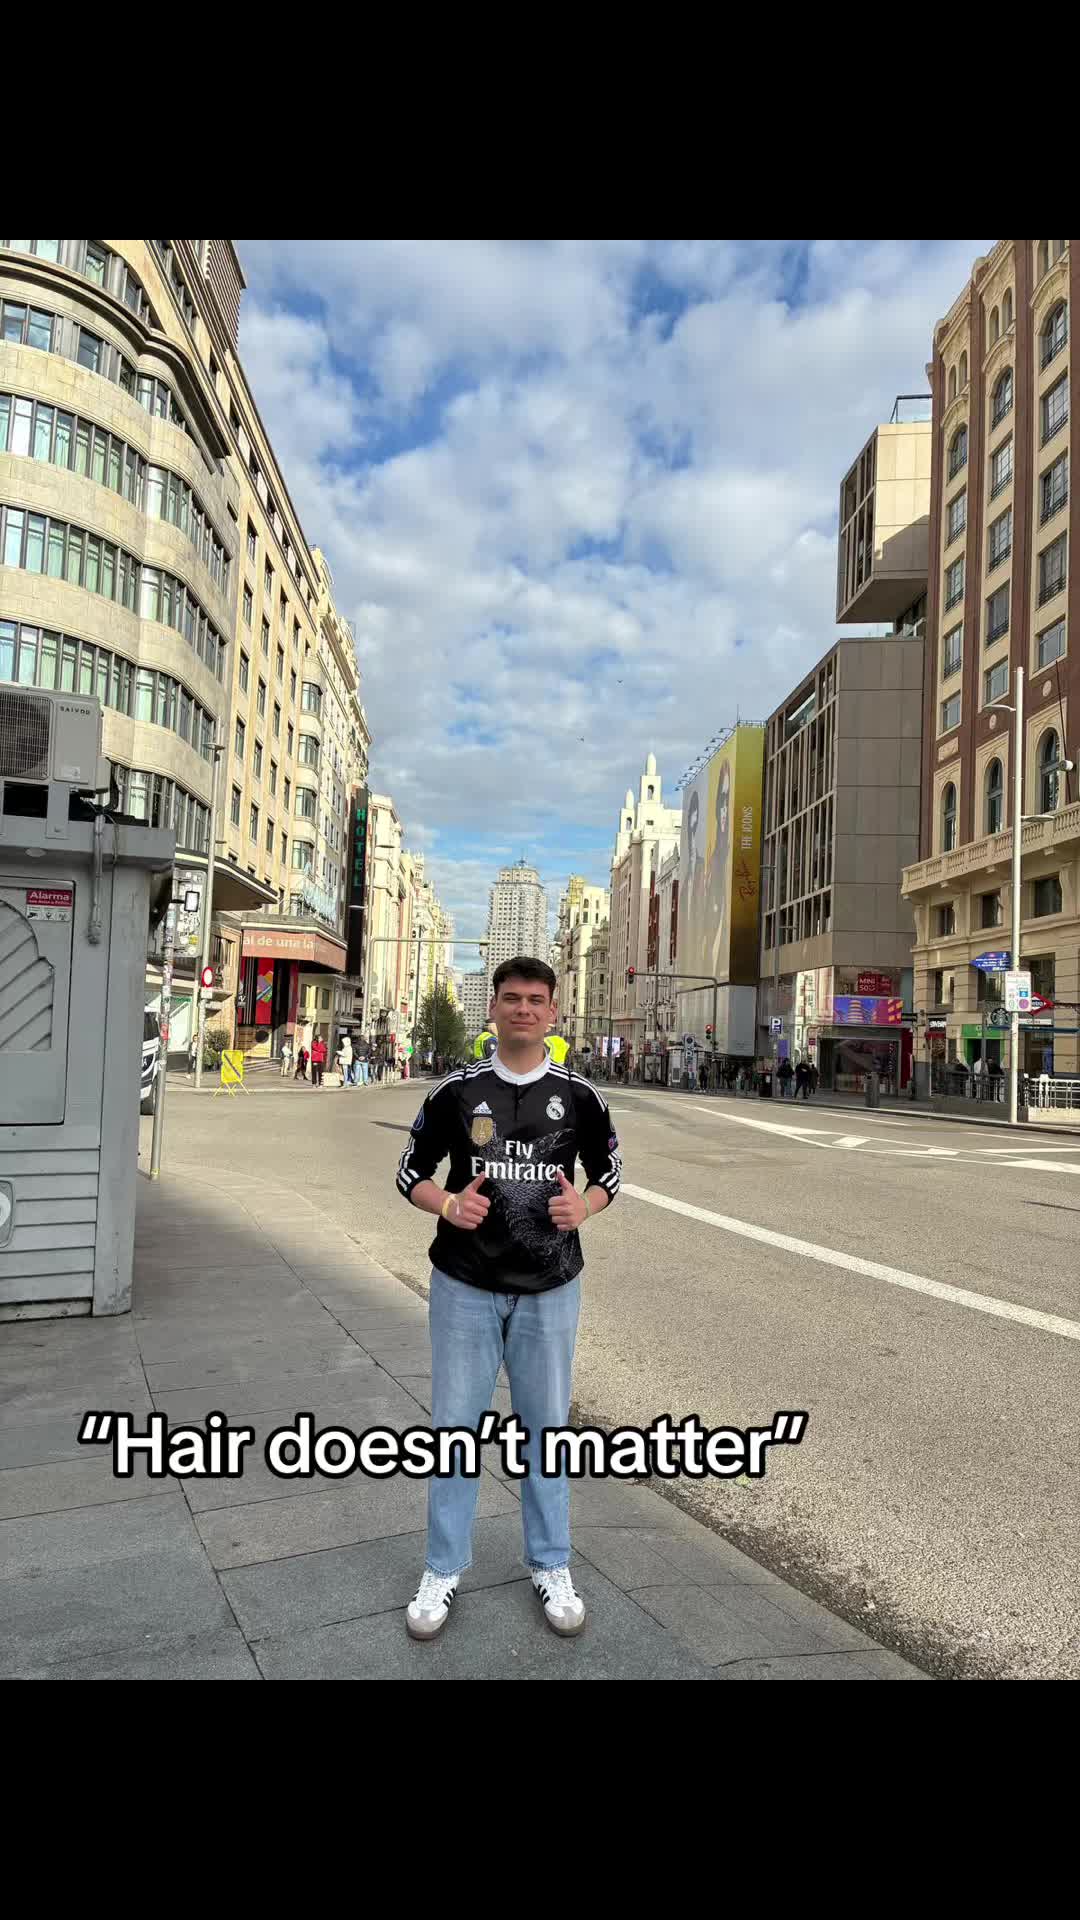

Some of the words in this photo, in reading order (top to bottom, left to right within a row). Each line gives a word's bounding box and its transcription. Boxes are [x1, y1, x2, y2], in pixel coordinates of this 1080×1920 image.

[353, 808, 366, 887] HOTEL
[30, 891, 70, 901] Alarma
[257, 936, 273, 946] de
[505, 1140, 534, 1160] Fly
[471, 1156, 565, 1181] Emirates
